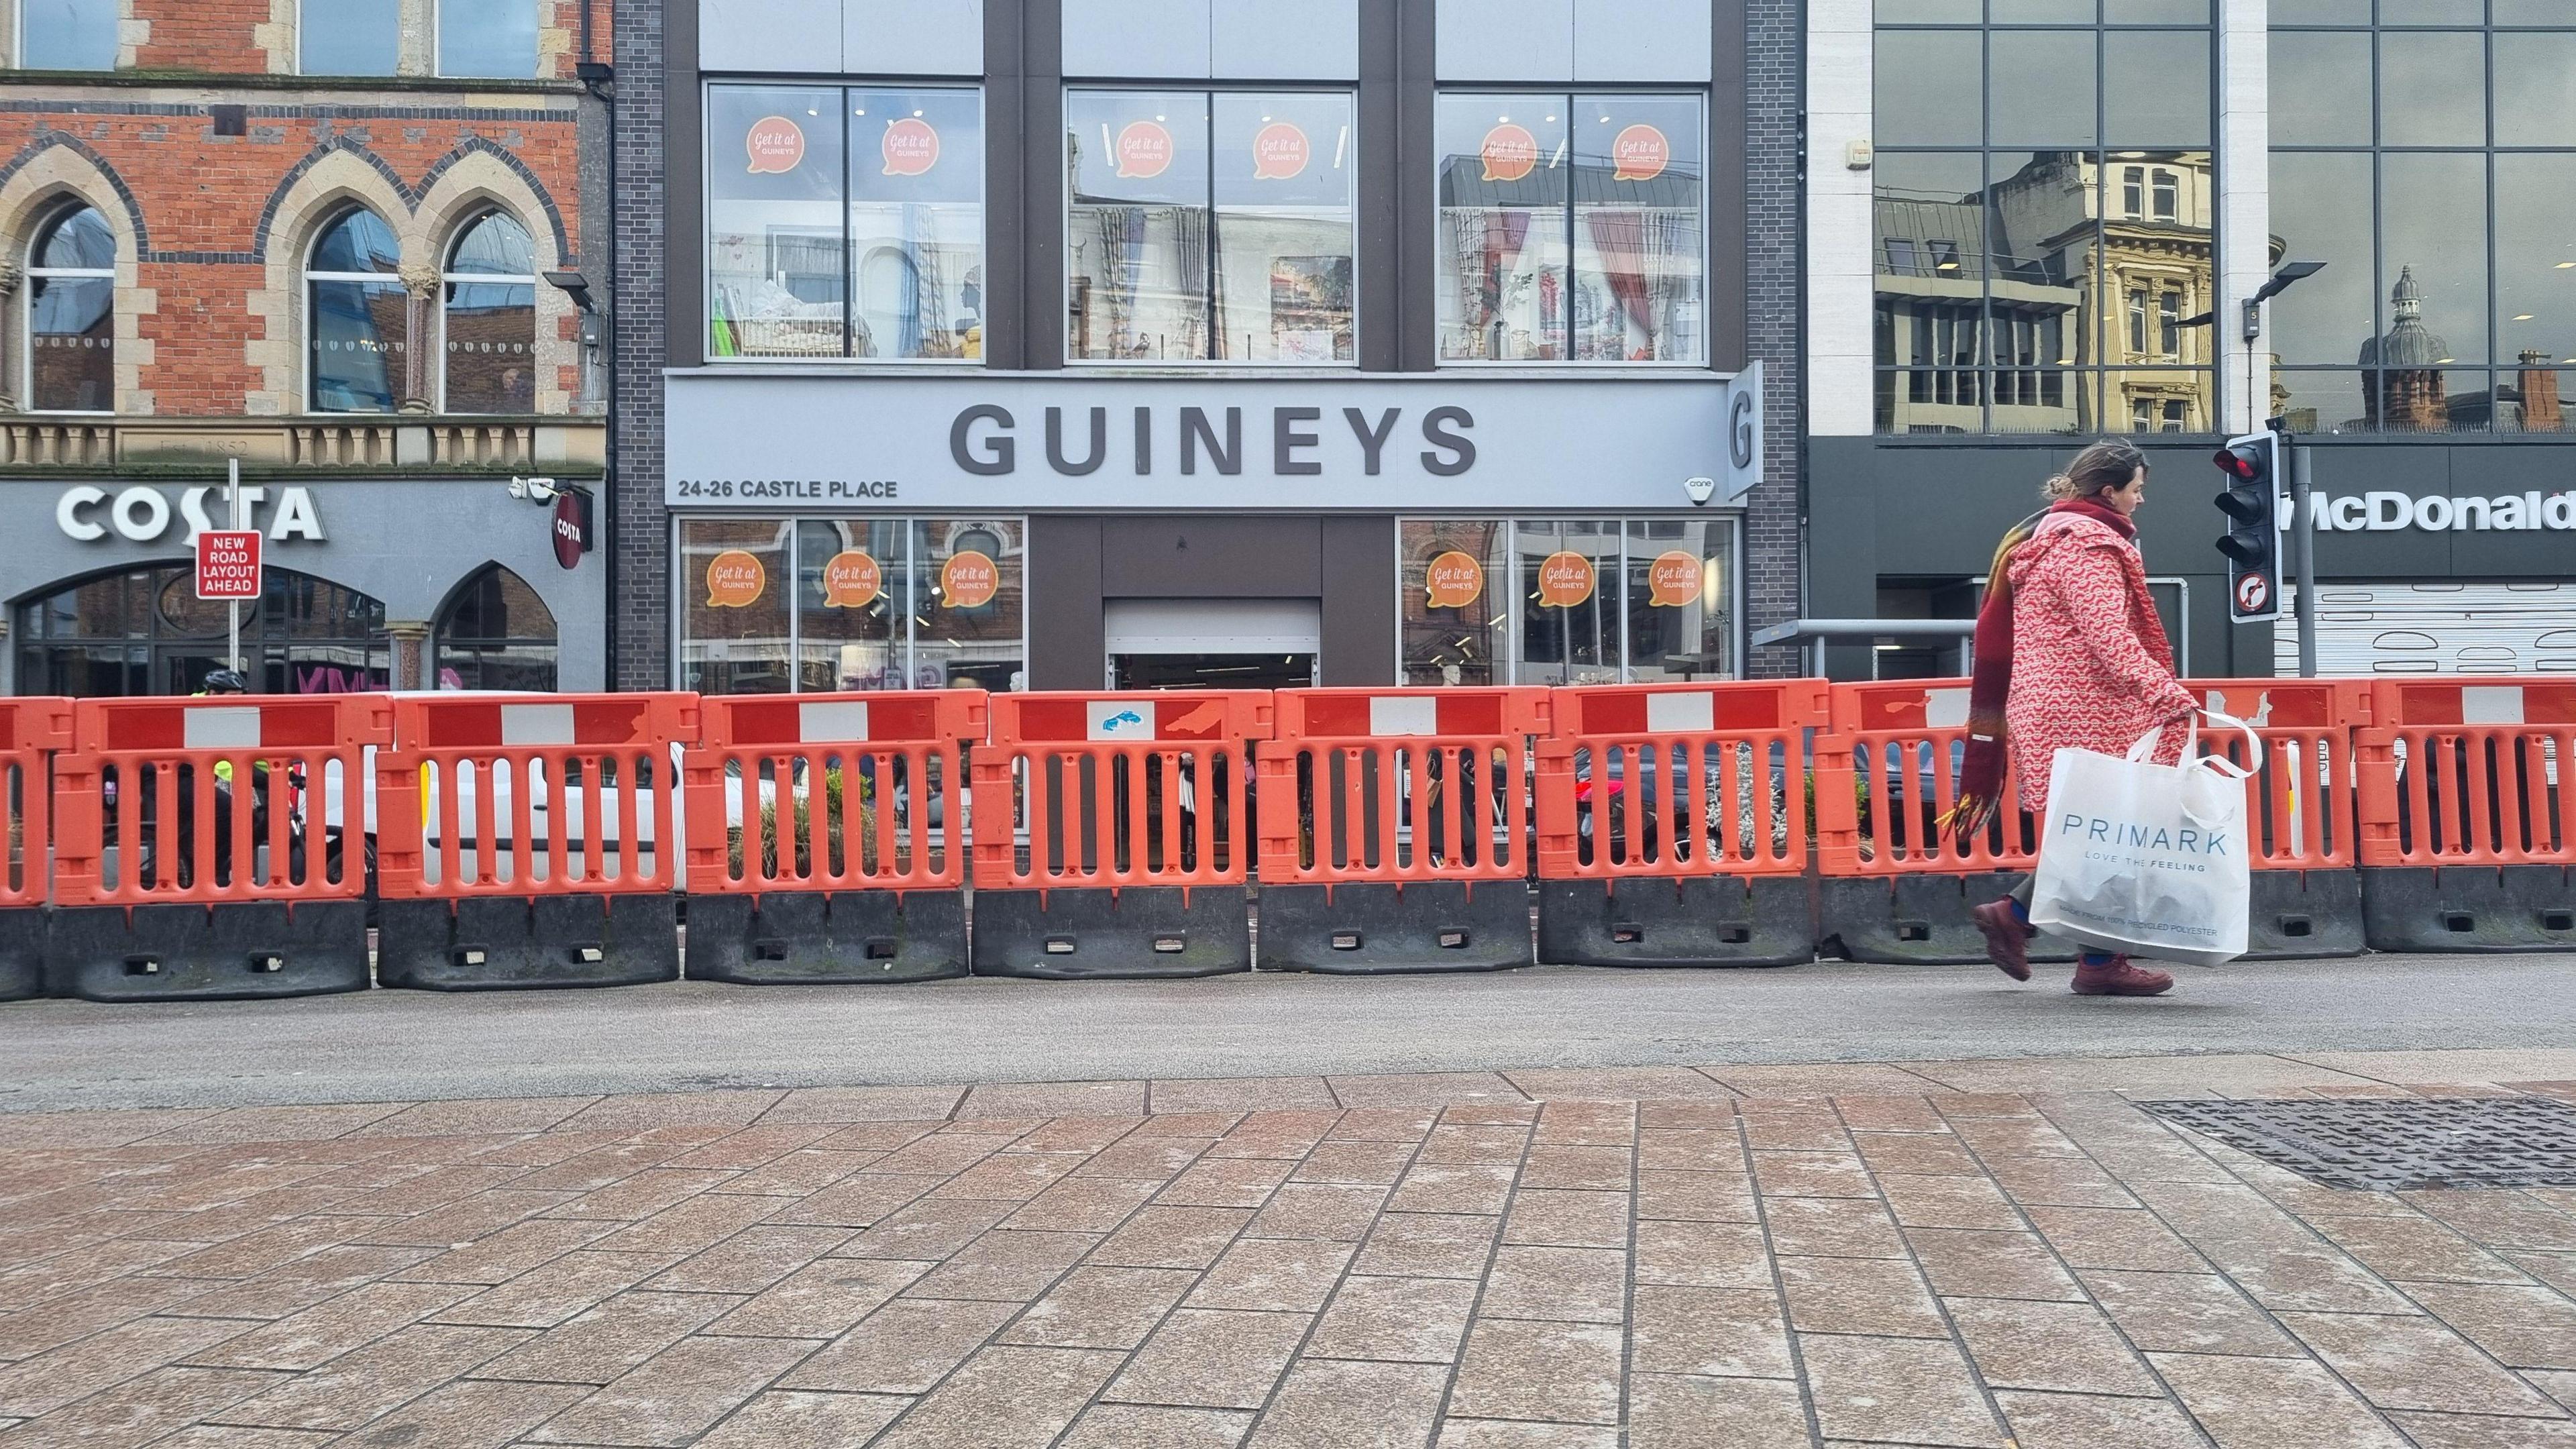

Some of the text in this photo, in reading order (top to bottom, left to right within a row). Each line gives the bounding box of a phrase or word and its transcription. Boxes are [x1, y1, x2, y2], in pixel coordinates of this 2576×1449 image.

[755, 133, 796, 150] Get it at
[890, 134, 930, 152] Get it at
[1124, 137, 1164, 155] Get it at
[1261, 140, 1300, 156] Get it at
[1489, 141, 1528, 157] Get it at
[1621, 141, 1660, 158] Get it at
[1729, 390, 1751, 469] G
[207, 440, 248, 456] 1852
[950, 404, 1477, 476] GUINEYS
[678, 480, 897, 497] 24-26 CASTLE PLACE
[56, 486, 327, 548] COSTA
[2280, 491, 2576, 531] McDonald
[557, 518, 581, 543] COSTA
[213, 537, 245, 549] NEW
[210, 551, 248, 564] ROAD
[203, 566, 255, 578] LAYOUT
[716, 566, 756, 584] Get it at
[833, 567, 872, 584] Get it at
[950, 568, 990, 584] Get it at
[1436, 568, 1474, 584] Get it at
[1547, 568, 1586, 584] Get it at
[1657, 566, 1696, 584] Get it at
[205, 580, 252, 592] AHEAD
[2062, 814, 2226, 856] PRIMARK
[2085, 851, 2206, 872] LOVE THE FEELING
[2082, 912, 2105, 921] FROM
[2127, 919, 2169, 931] RECYCLED
[2171, 924, 2218, 936] POLYESTER
